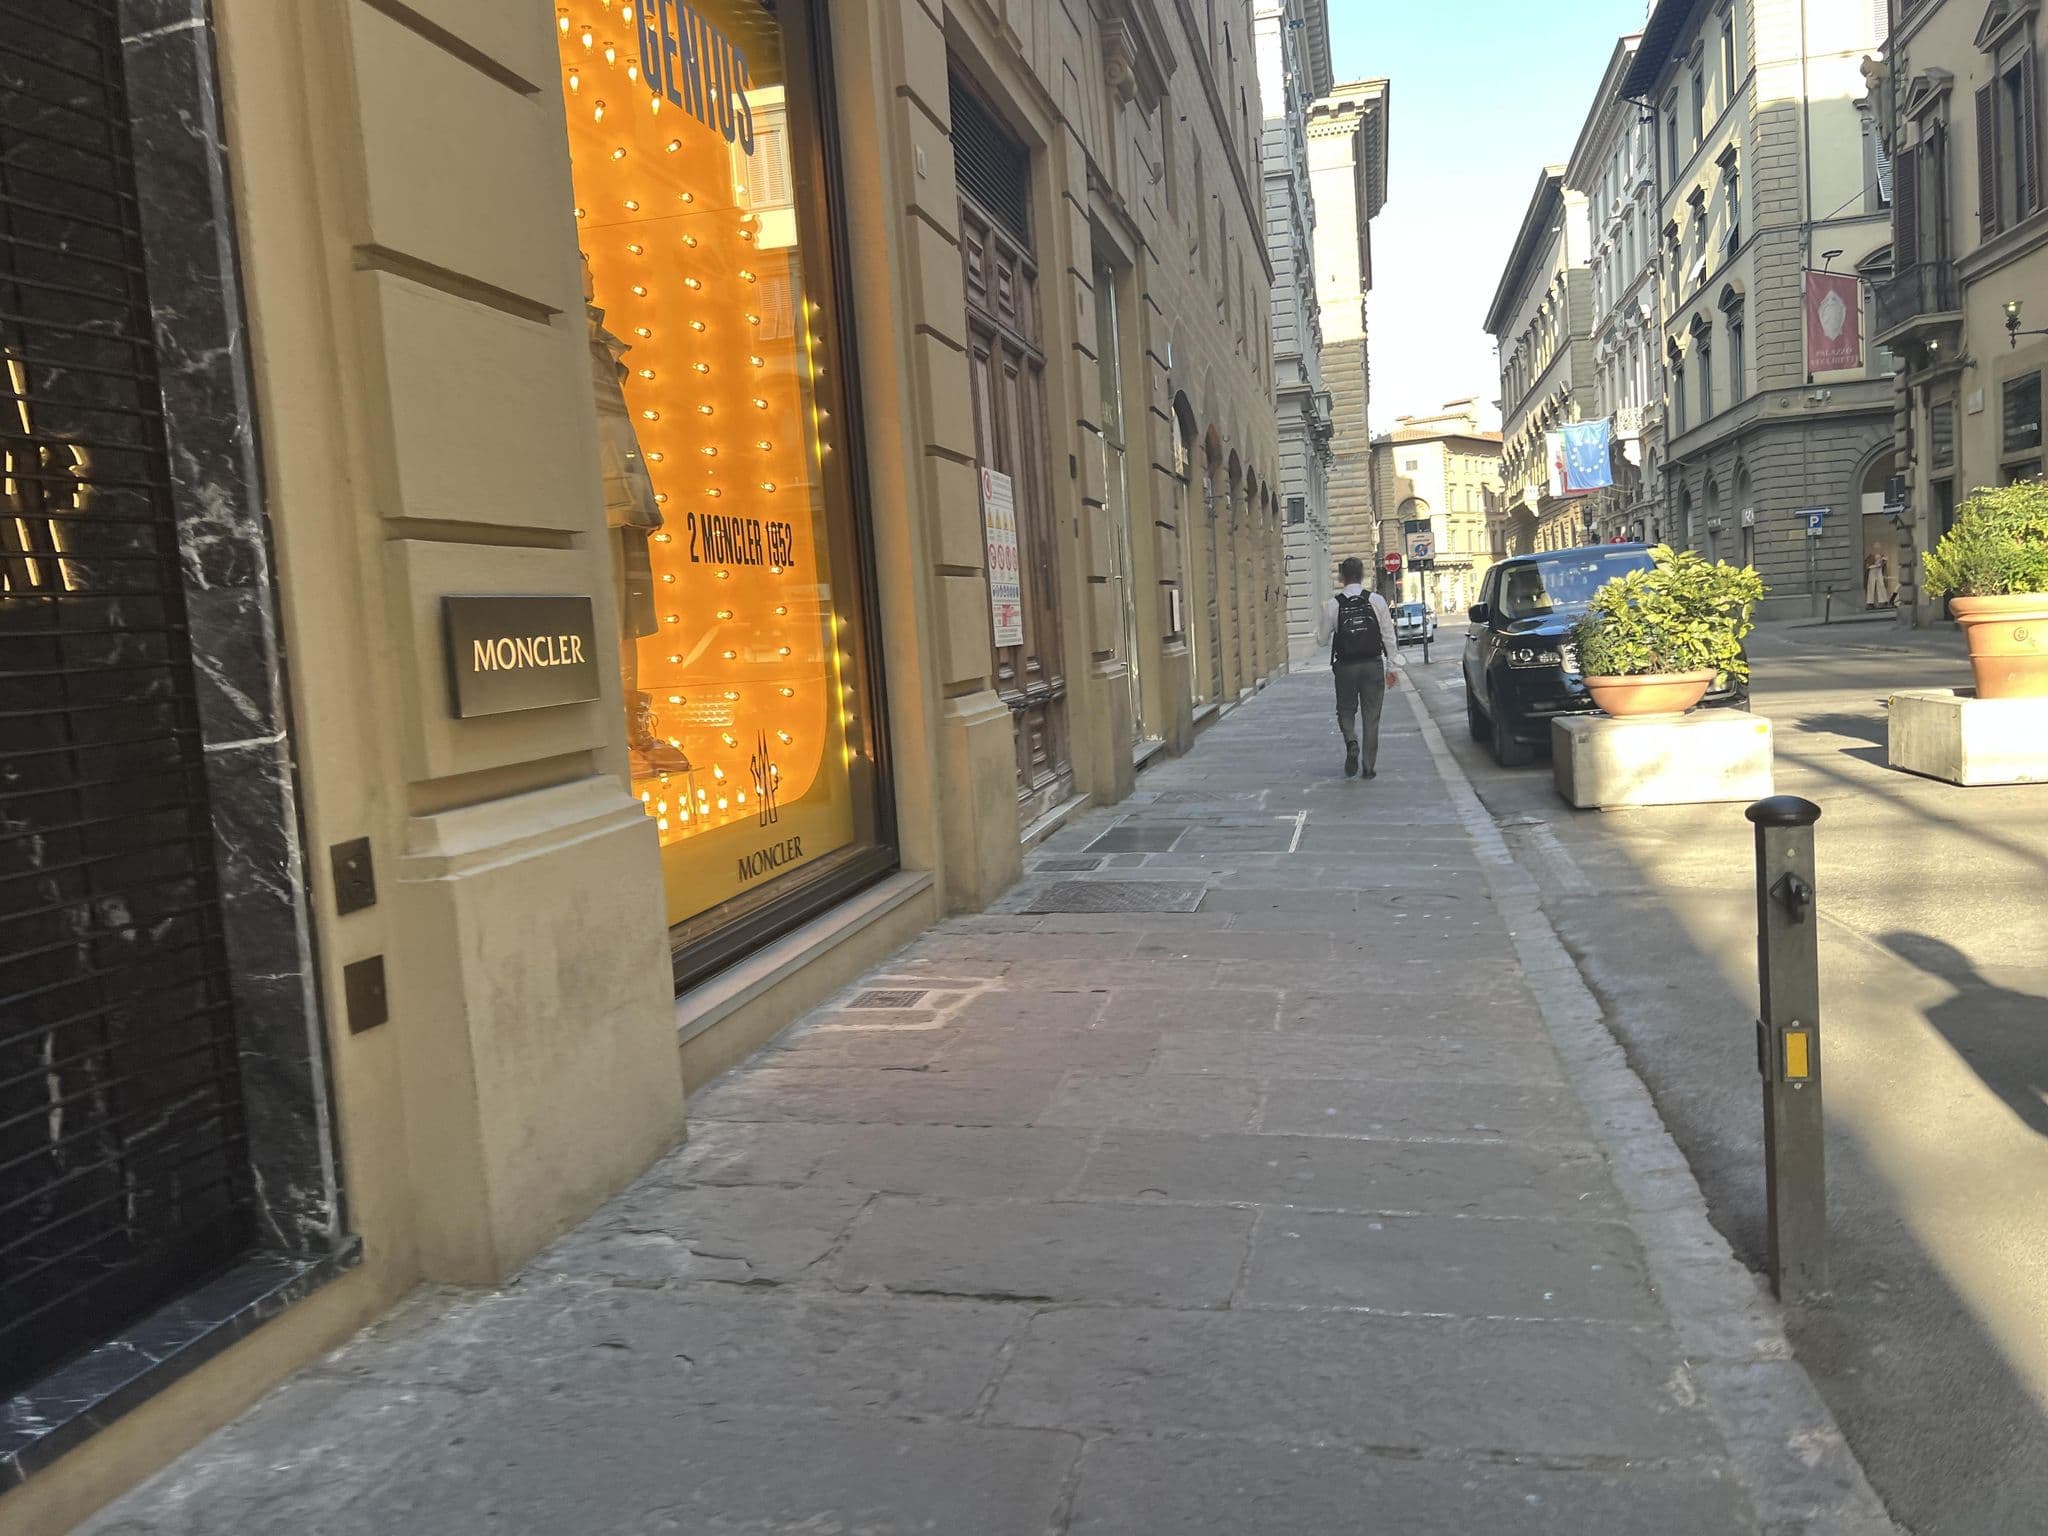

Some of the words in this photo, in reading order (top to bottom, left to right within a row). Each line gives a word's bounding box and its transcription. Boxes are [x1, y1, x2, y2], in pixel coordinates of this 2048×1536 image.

[635, 0, 754, 156] GENIUS
[687, 511, 700, 563] 2
[701, 513, 763, 566] MONCLER
[764, 520, 795, 567] 1952
[1810, 515, 1819, 527] P
[473, 635, 586, 672] MONCLER
[737, 836, 804, 883] MONCLER
